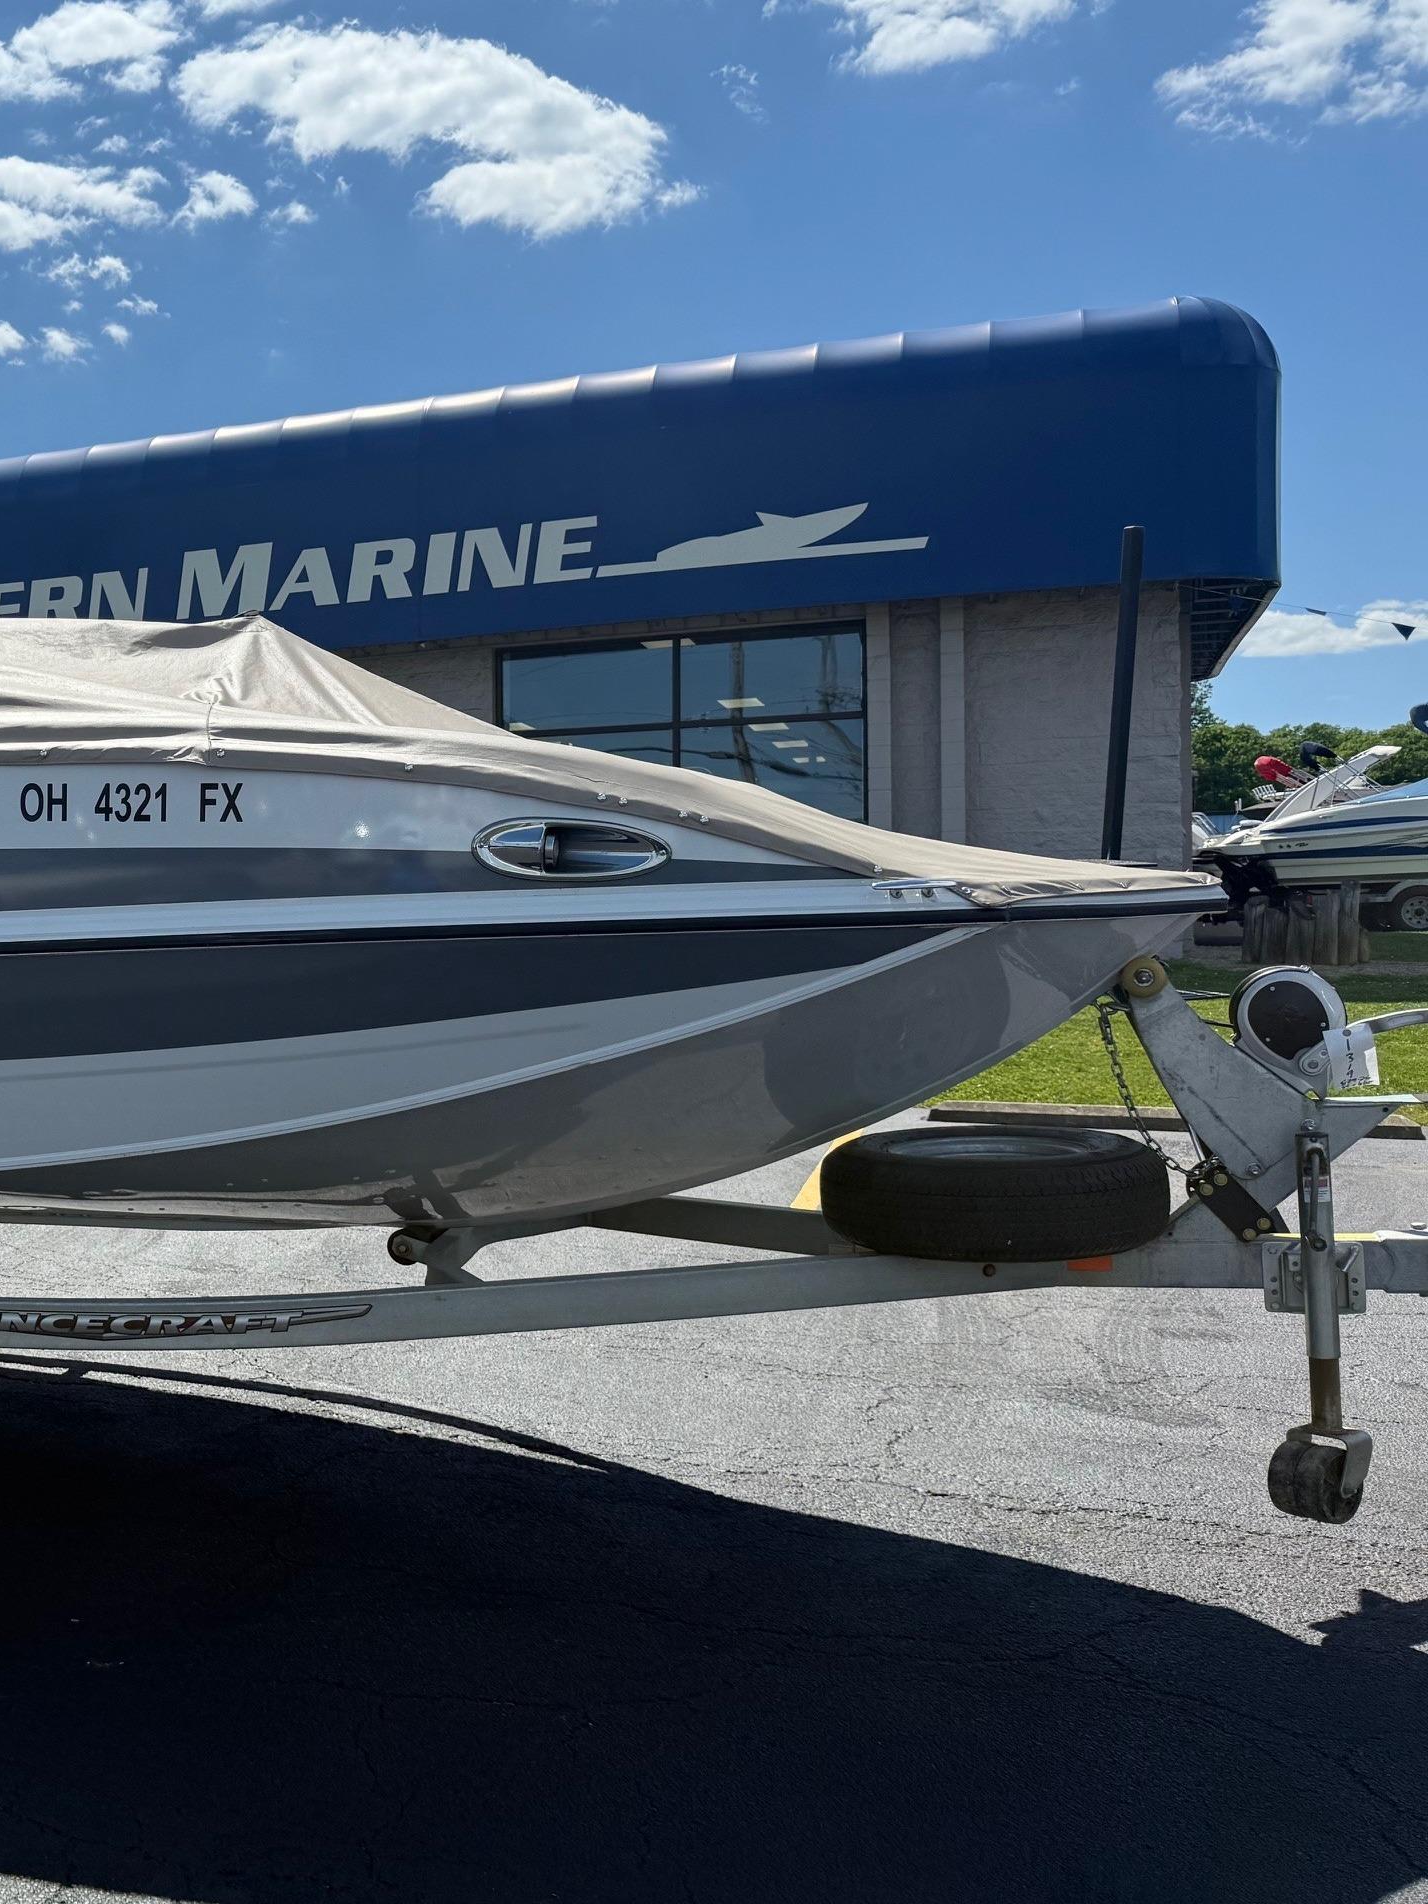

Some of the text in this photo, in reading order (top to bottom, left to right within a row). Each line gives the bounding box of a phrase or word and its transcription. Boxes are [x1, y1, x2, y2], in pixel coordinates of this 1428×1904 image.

[176, 515, 597, 620] MARINE
[20, 782, 244, 823] OH 4321 FX
